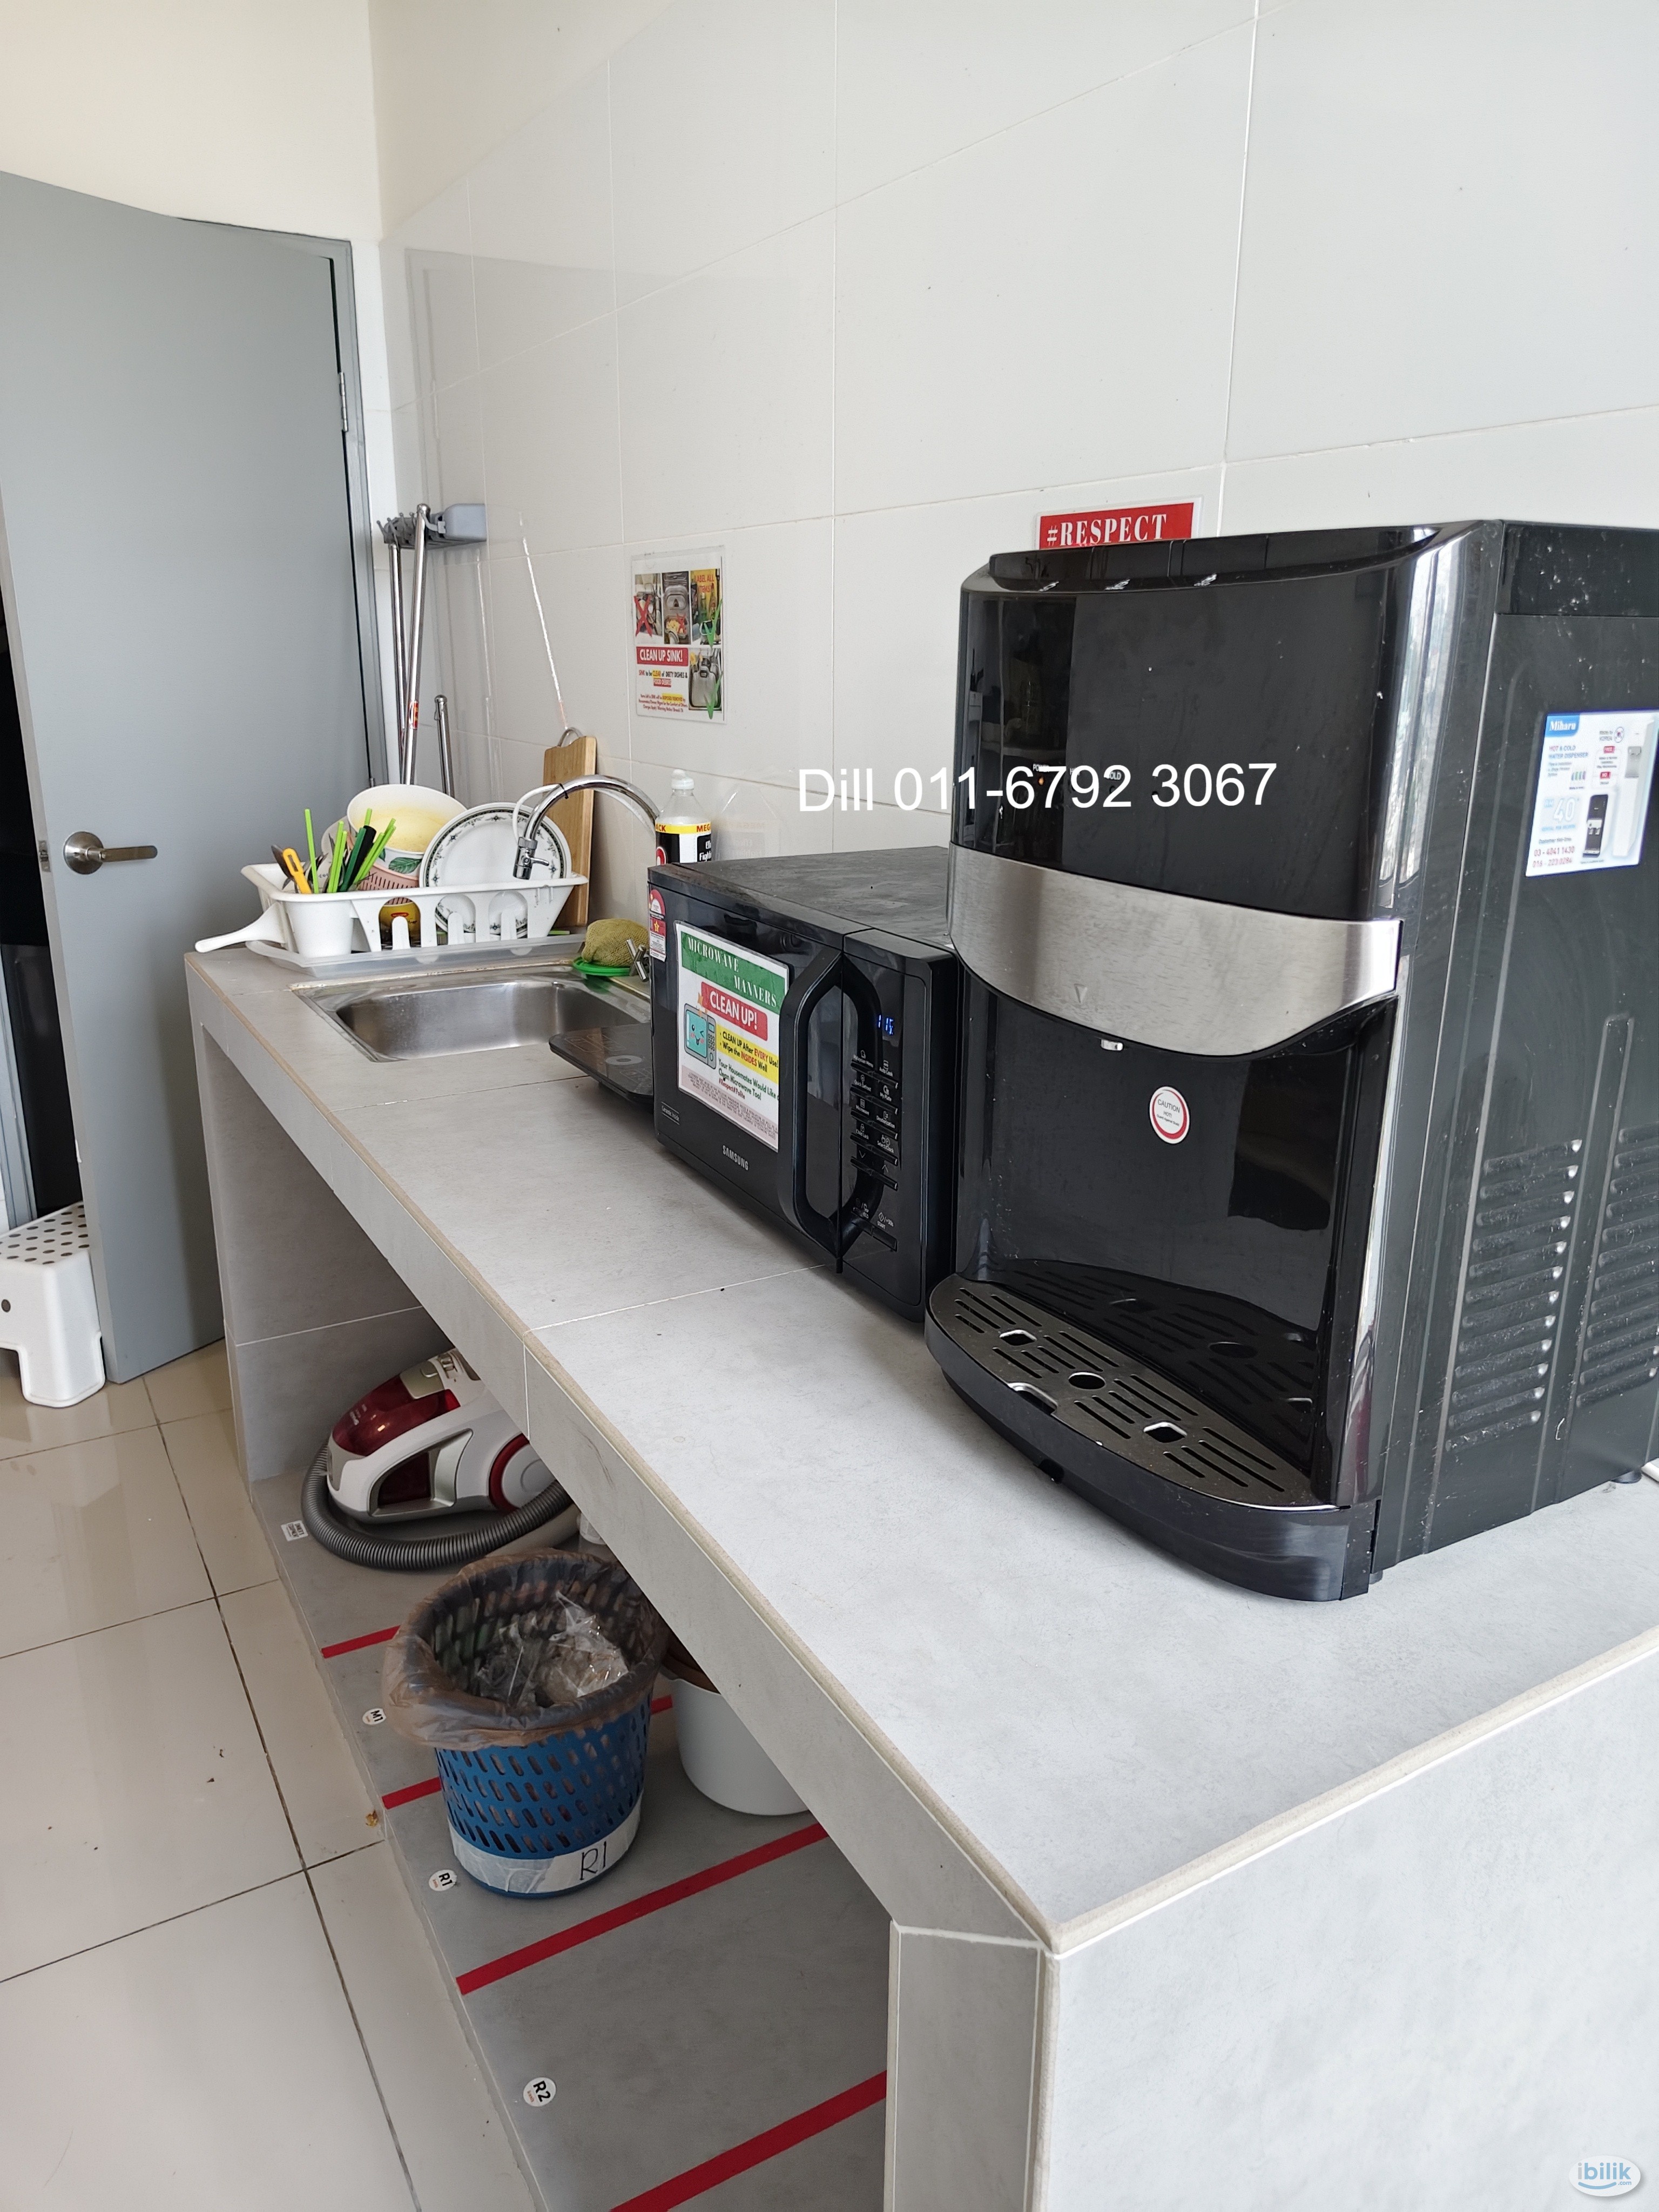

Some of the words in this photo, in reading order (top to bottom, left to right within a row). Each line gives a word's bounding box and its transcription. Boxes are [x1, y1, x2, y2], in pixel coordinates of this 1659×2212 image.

[1047, 514, 1166, 547] #RESPECT
[639, 649, 657, 662] CLEAN
[658, 650, 666, 662] UP
[667, 650, 683, 662] SINK!
[687, 936, 739, 973] MICROWAVE
[734, 975, 777, 1007] MANNERS
[710, 991, 739, 1021] CLEAN
[741, 1006, 757, 1030] UP!
[723, 1031, 736, 1045] CLEAN
[737, 1038, 743, 1048] UP
[743, 1042, 753, 1054] After
[754, 1048, 768, 1062] EVERY
[769, 1056, 778, 1068] Use!
[723, 1041, 733, 1054] Wipe
[740, 1051, 757, 1067] INSIDES
[758, 1060, 767, 1073] Well
[718, 1057, 727, 1069] Your
[729, 1064, 752, 1084] Housemates
[752, 1078, 767, 1093] Would
[767, 1087, 776, 1098] Like
[718, 1068, 730, 1080] Clean
[730, 1075, 751, 1094] Microwave
[752, 1088, 761, 1101] Too!
[1158, 1099, 1180, 1113] CAUTION
[723, 1145, 748, 1171] SAMSUNG
[370, 1710, 383, 1722] M1
[439, 1872, 453, 1886] R1
[533, 2080, 551, 2102] R2
